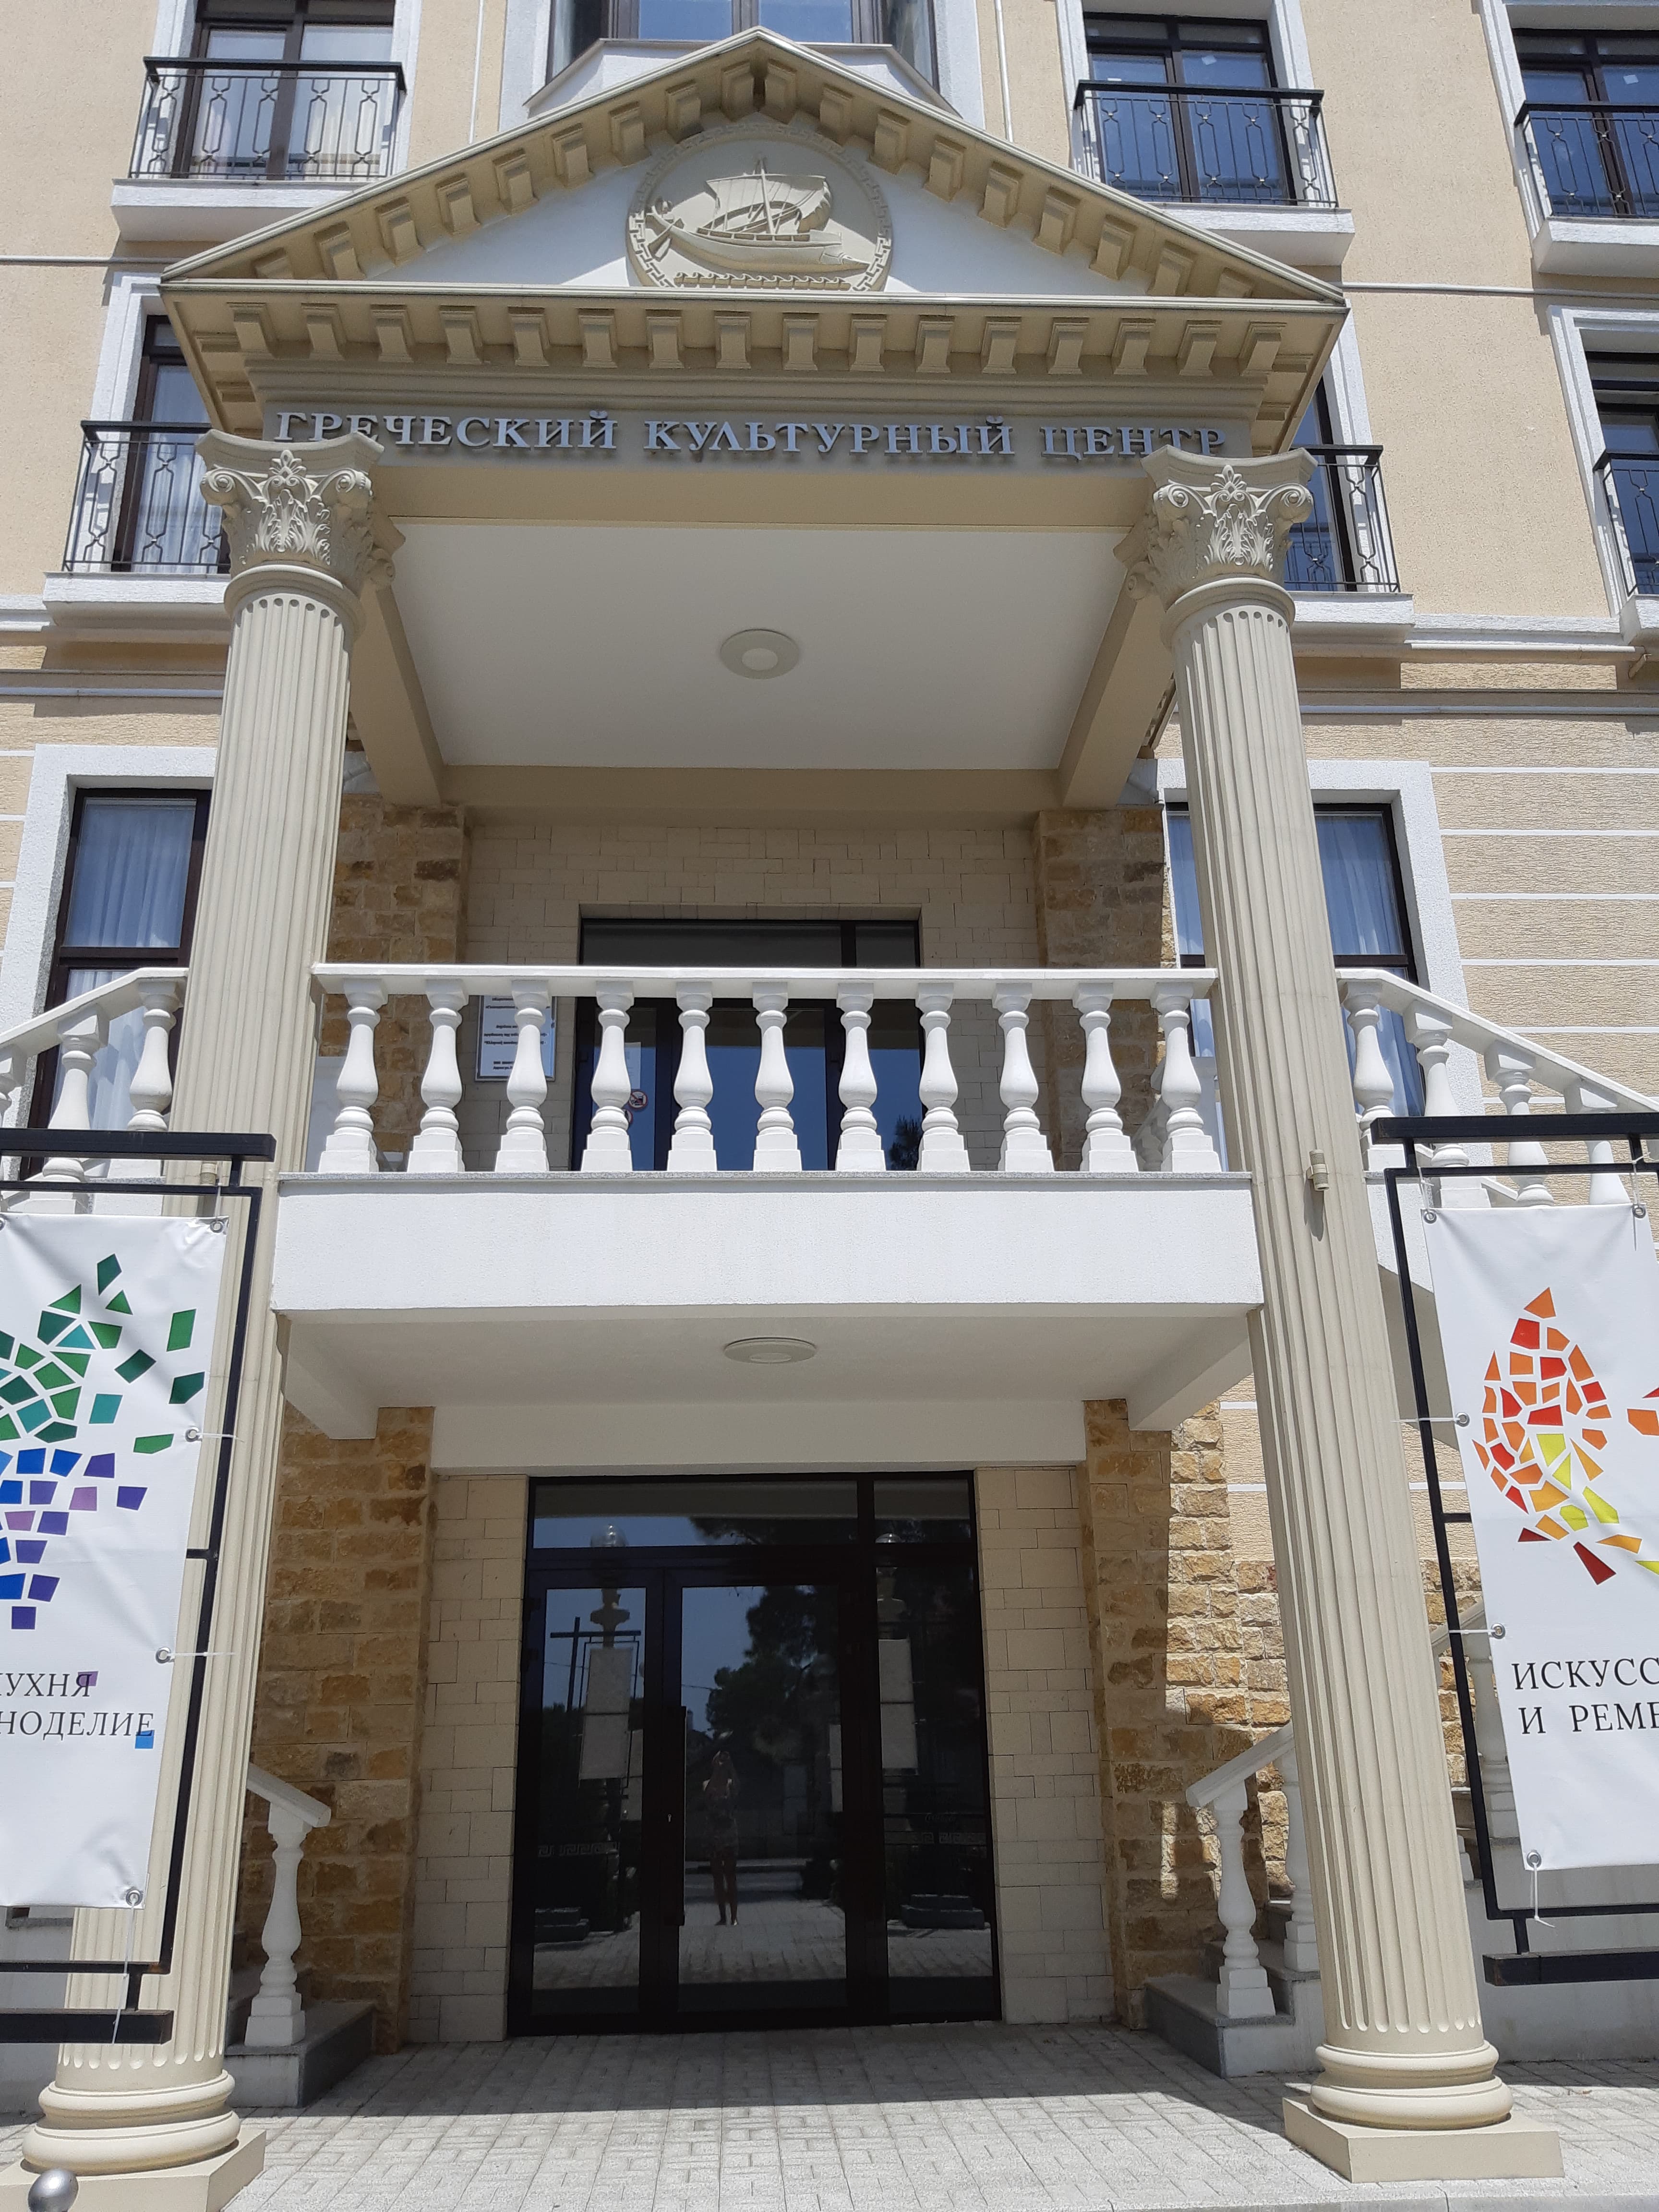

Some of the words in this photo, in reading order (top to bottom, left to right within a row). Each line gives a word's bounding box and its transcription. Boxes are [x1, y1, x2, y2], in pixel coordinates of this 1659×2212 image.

[274, 410, 618, 449] ГРЕЧЕСКИЙ
[643, 415, 1015, 456] КУЛЬТУРНЫЙ
[1040, 426, 1226, 462] ЦЕНТР
[0, 1672, 92, 1697] УХНЯ
[1512, 1658, 1659, 1690] ИСКУСС
[1518, 1707, 1546, 1734] И
